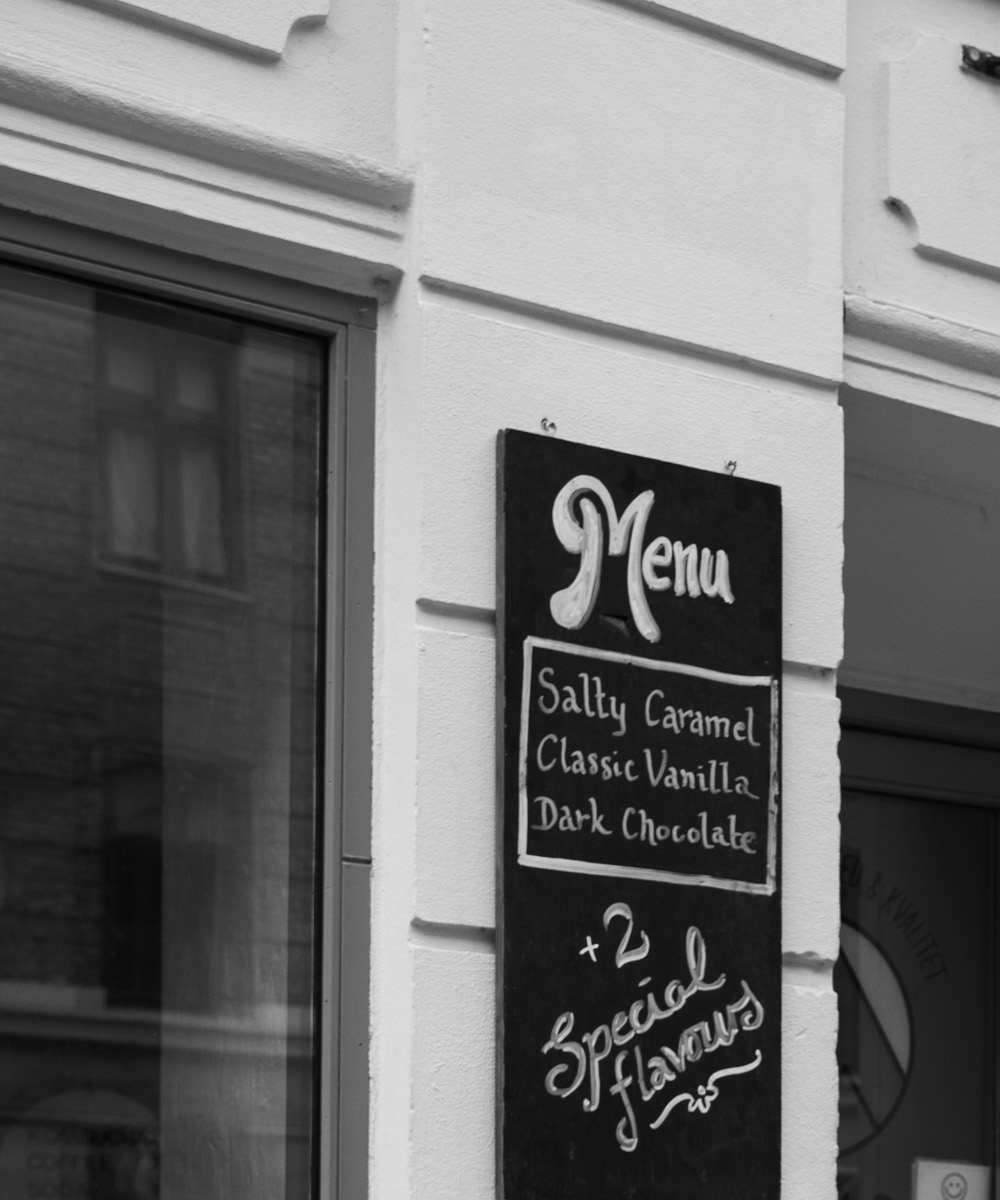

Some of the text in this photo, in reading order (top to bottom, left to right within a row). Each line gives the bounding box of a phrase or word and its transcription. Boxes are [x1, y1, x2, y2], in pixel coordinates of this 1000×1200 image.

[549, 473, 735, 643] Menu
[538, 666, 760, 747] Salty Caramel
[537, 734, 760, 800] Classic Vanilla
[531, 796, 757, 853] Dark Chocolate
[882, 886, 950, 981] KVALITET
[541, 925, 726, 1112] Special
[610, 979, 764, 1152] flavours
